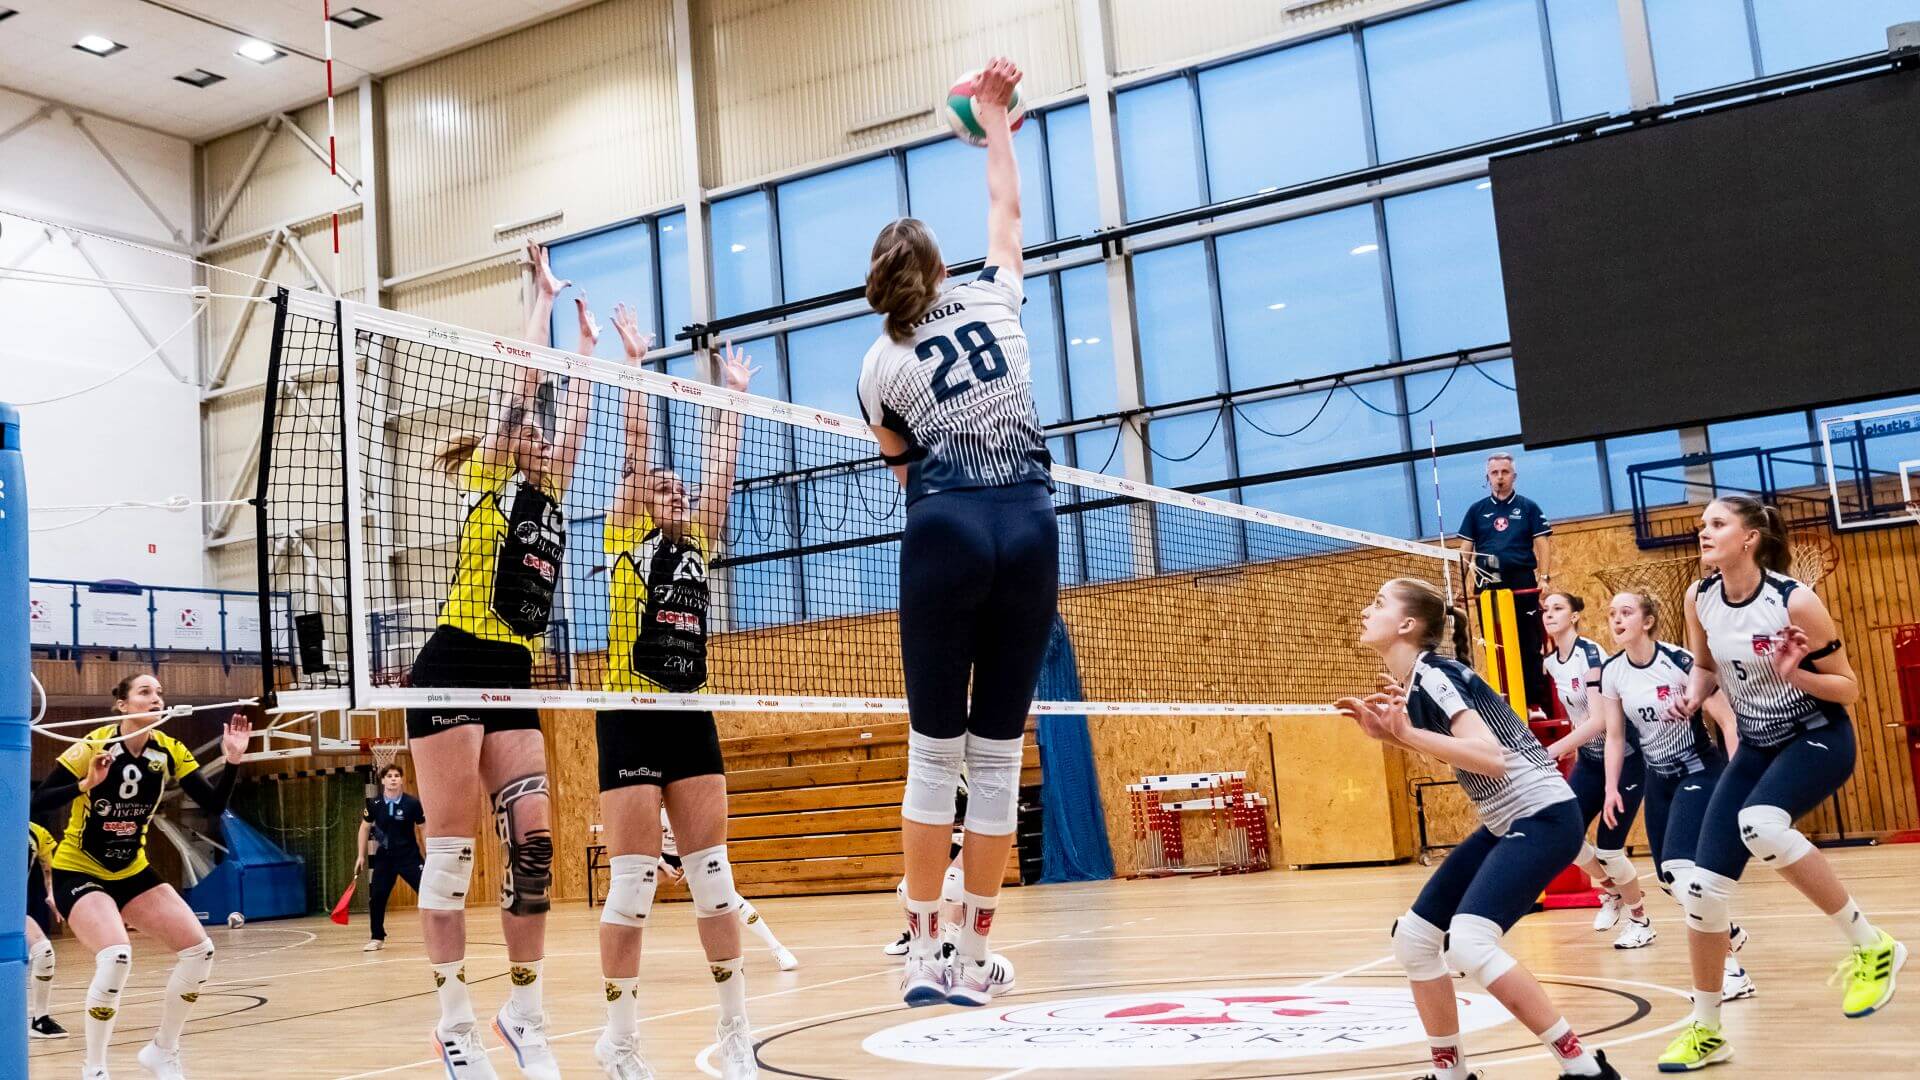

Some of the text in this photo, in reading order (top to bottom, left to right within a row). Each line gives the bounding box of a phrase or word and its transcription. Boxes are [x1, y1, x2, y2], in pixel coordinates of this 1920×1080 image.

[506, 347, 532, 359] ORLEN
[914, 320, 1009, 404] 28
[823, 417, 841, 428] ORLEN
[1732, 660, 1748, 681] 5
[427, 693, 443, 702] plus
[491, 694, 511, 702] ORLEN
[1638, 706, 1660, 723] 22
[118, 763, 143, 800] 8
[901, 1032, 1387, 1044] SZCZYRK
